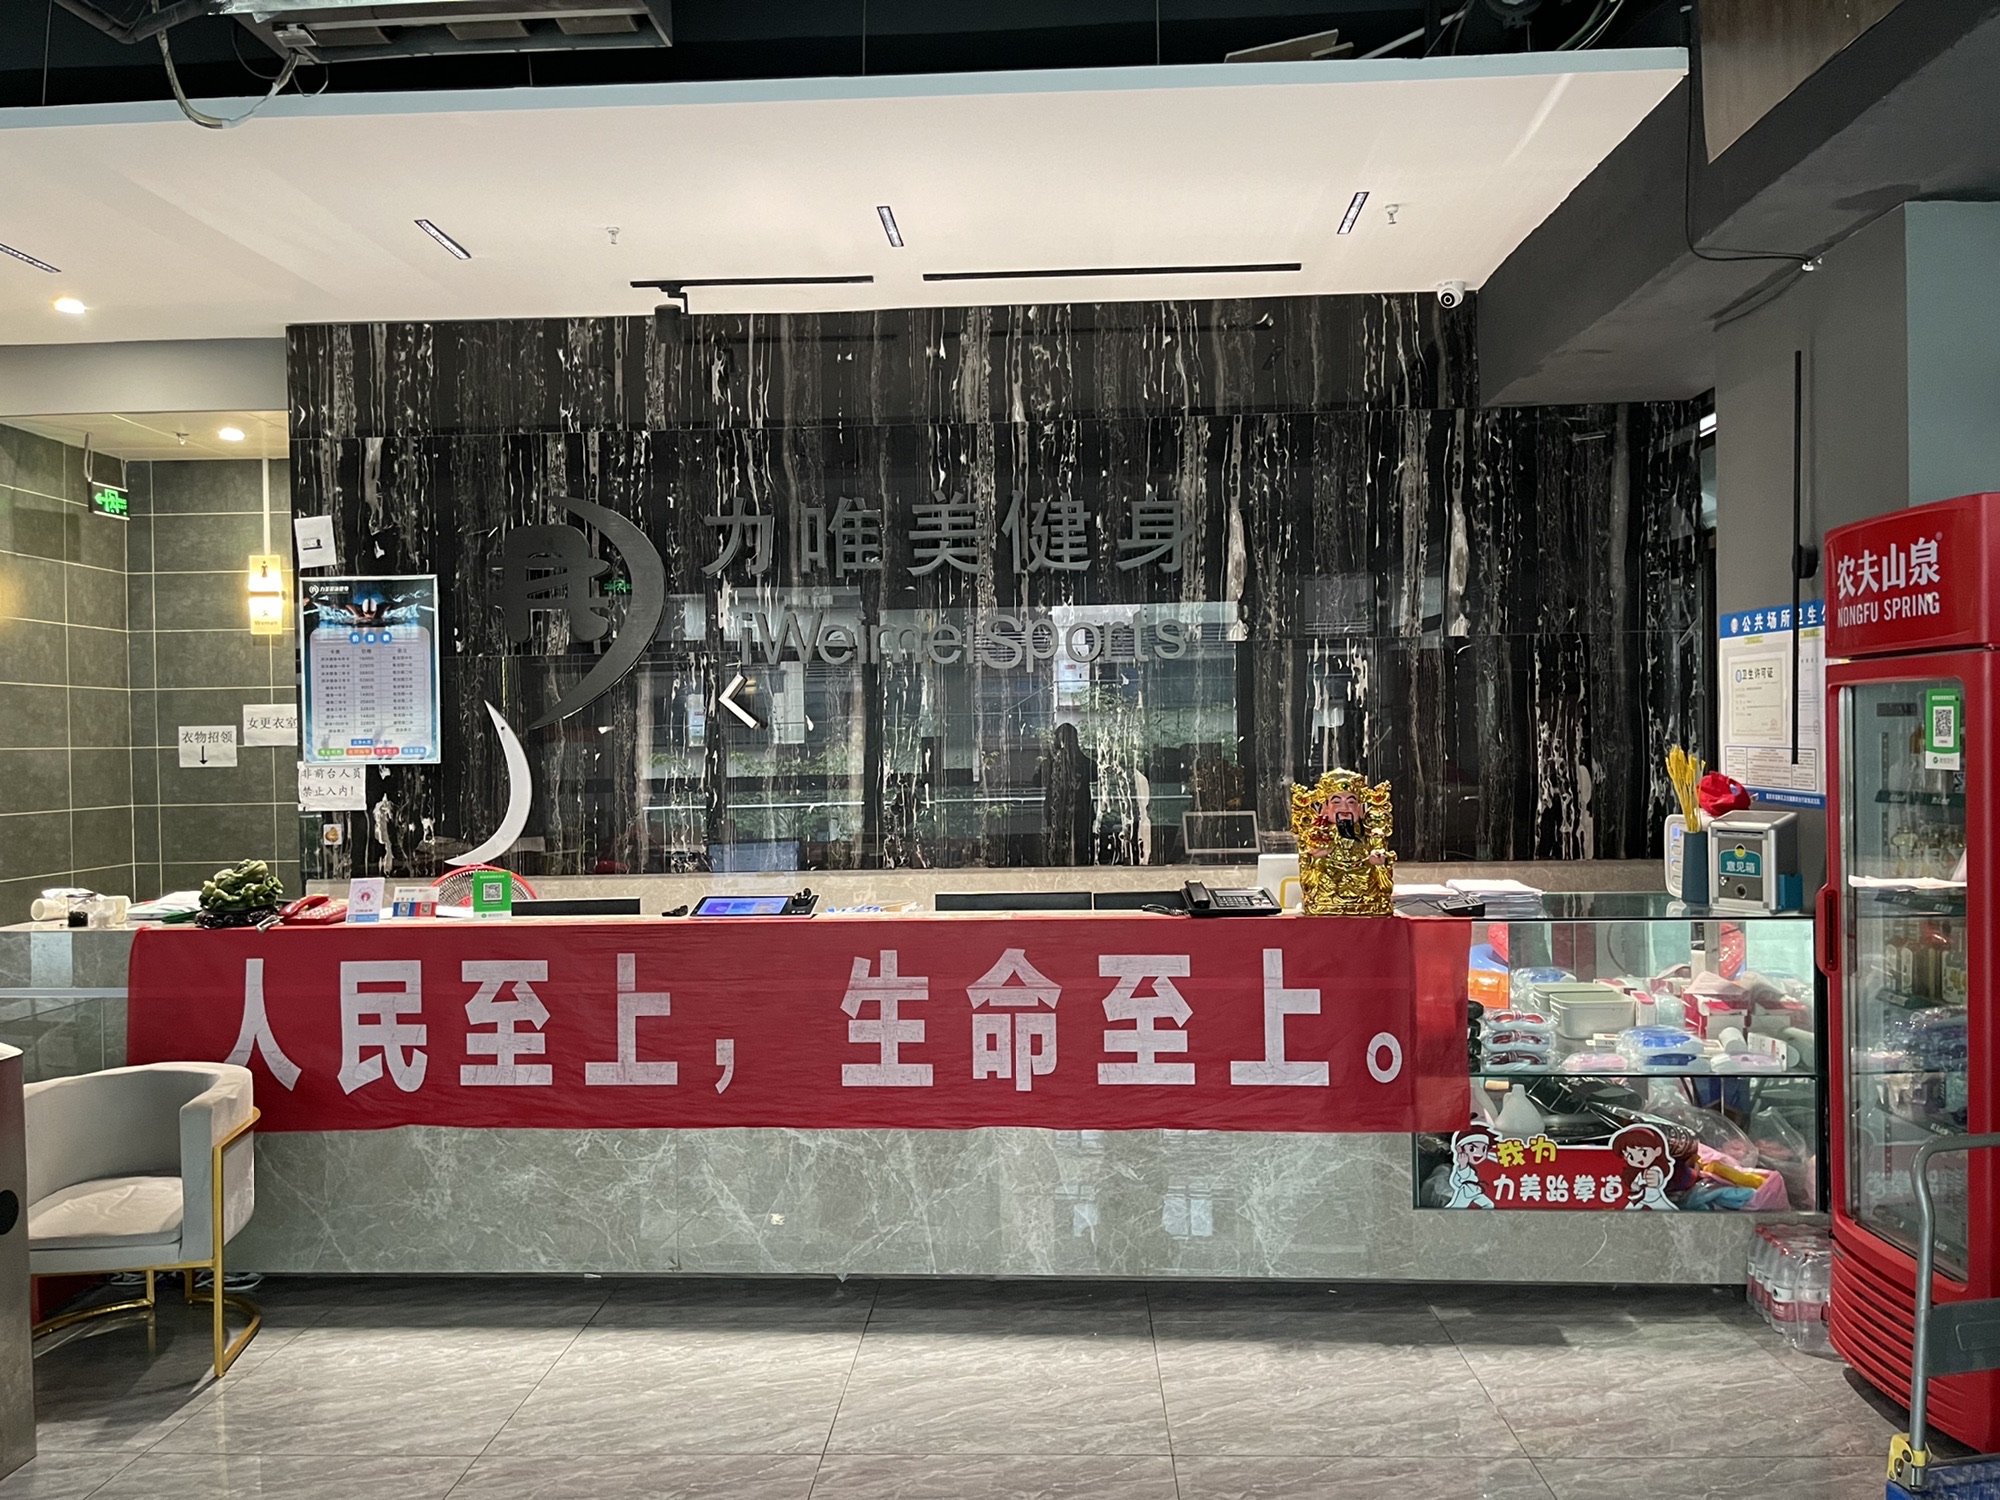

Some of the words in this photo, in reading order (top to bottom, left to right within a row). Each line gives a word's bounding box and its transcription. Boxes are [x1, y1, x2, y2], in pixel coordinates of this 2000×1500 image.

[701, 489, 1197, 578] 力唯美健身
[1837, 537, 1941, 600] 农夫山泉
[1838, 601, 1879, 628] NONGFU
[1883, 592, 1940, 621] SPRING
[740, 611, 1188, 673] iWeimeiSports
[181, 731, 234, 744] 衣物招领
[246, 717, 298, 730] 女更衣室
[300, 768, 362, 780] 非前台人员
[1725, 861, 1756, 874] 意见箱
[1496, 1135, 1557, 1168] 我为
[1493, 1174, 1623, 1204] 力美跆拳道
